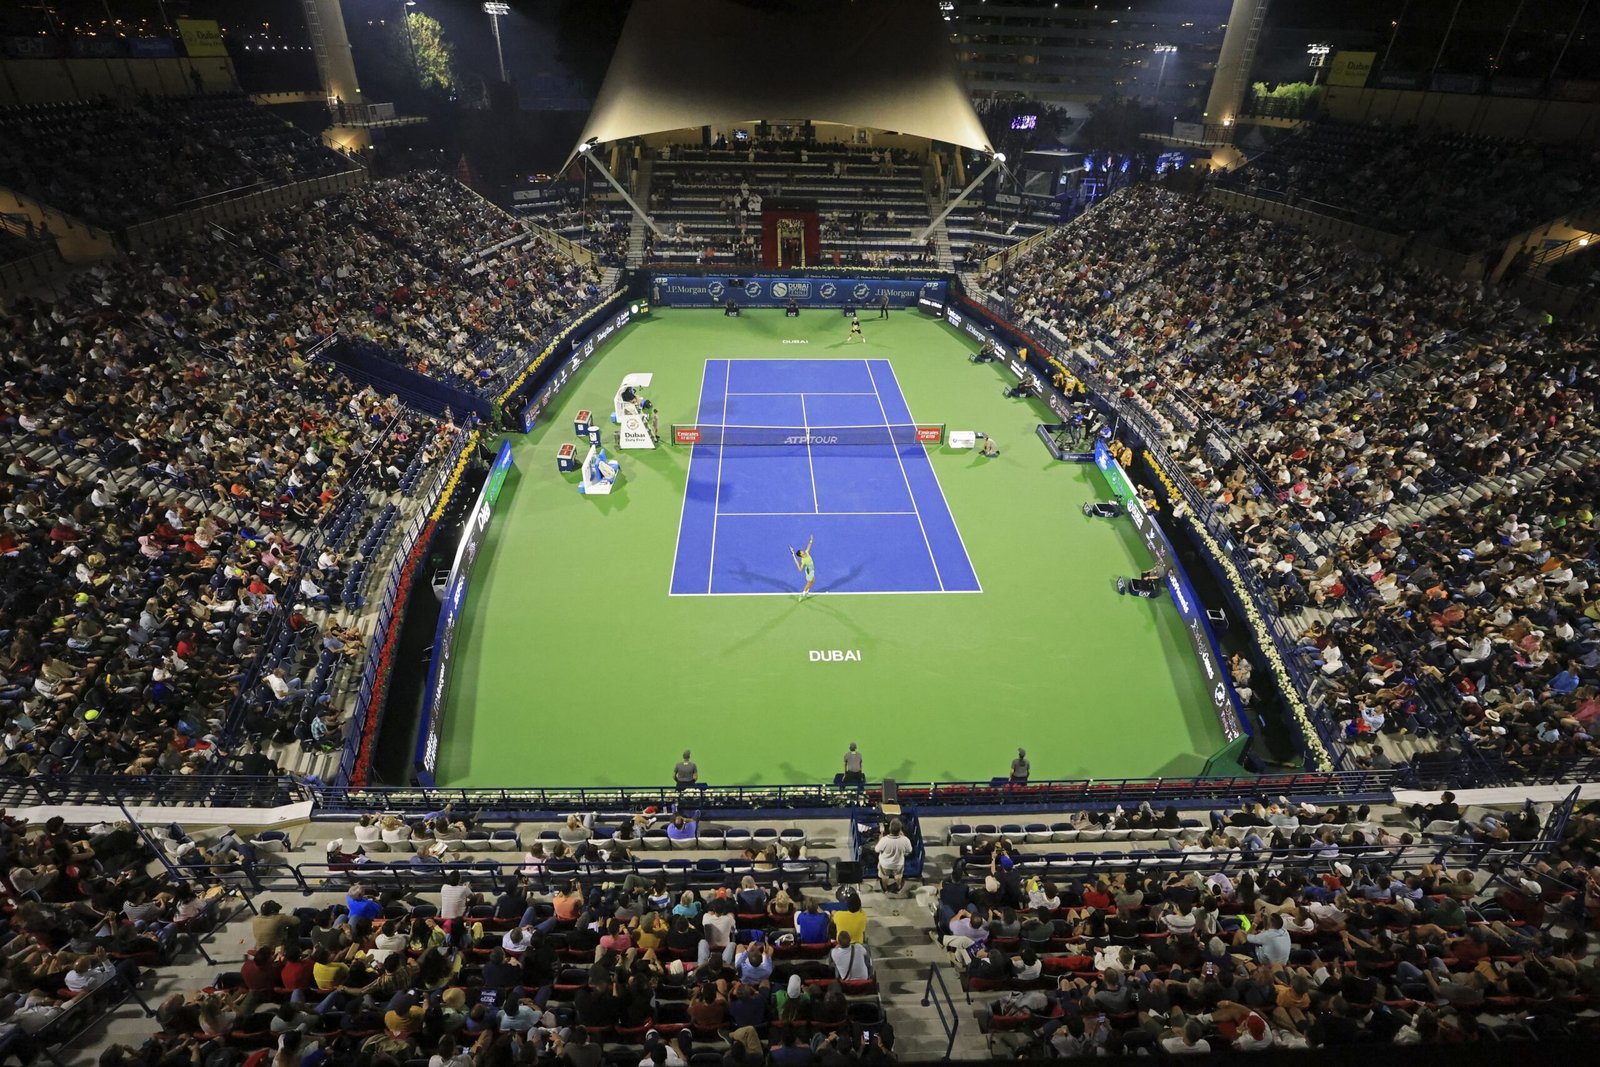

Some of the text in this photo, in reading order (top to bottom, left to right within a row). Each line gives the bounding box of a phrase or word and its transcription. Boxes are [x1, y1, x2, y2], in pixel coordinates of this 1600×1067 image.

[784, 436, 838, 444] ATP TOUR
[809, 650, 862, 662] DUBAI
